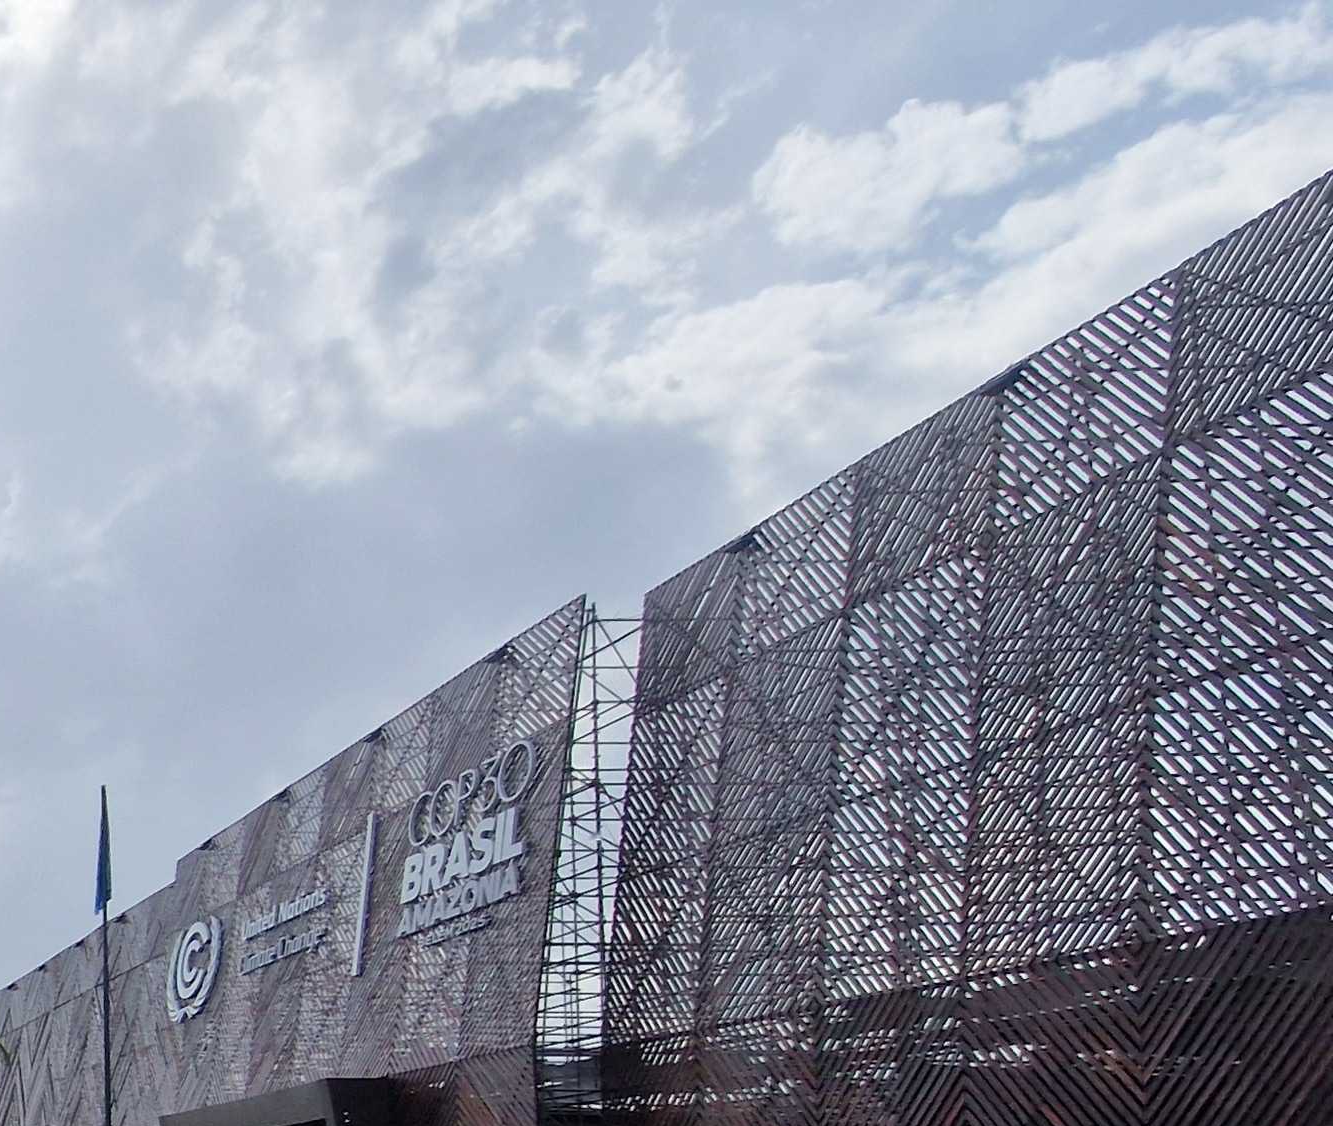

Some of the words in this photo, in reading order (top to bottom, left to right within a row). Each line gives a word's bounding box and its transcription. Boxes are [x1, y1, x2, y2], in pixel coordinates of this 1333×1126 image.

[408, 741, 533, 846] COP30
[400, 806, 523, 905] BRASIL
[278, 889, 327, 922] Nations
